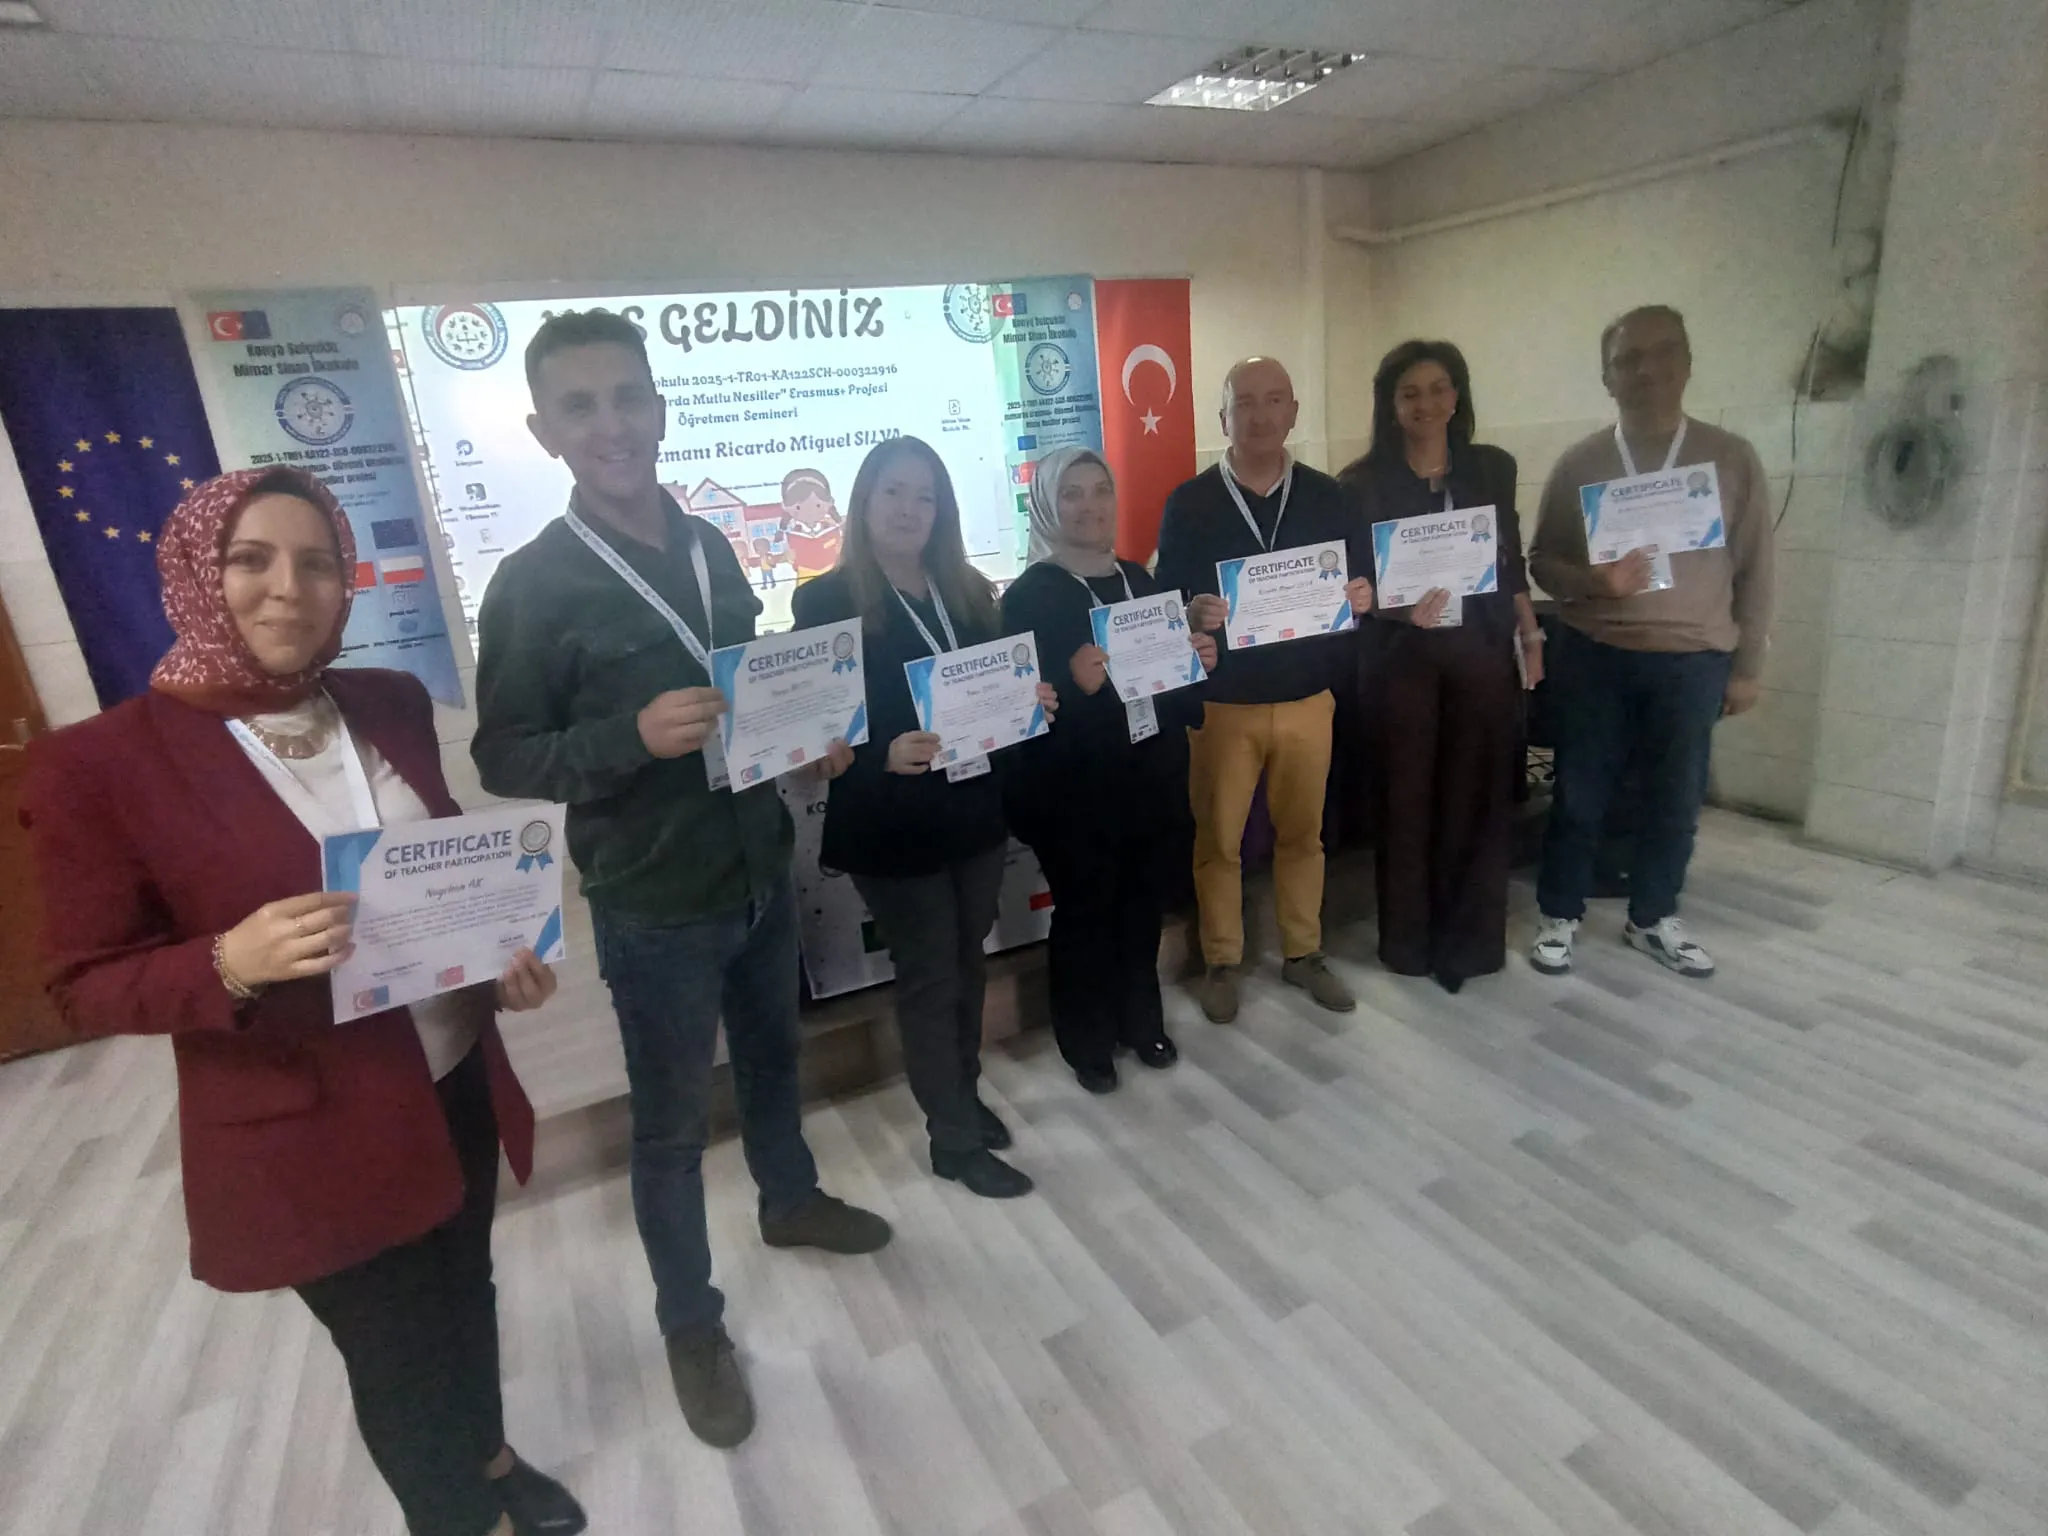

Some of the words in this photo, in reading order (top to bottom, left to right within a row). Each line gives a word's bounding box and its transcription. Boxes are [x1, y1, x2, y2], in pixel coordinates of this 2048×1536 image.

[660, 288, 884, 353] GELDİNİZ
[692, 392, 731, 405] Mutlu
[789, 387, 846, 399] Erasmus+
[848, 382, 888, 396] Projesi
[678, 411, 739, 428] Öğretmen
[744, 407, 798, 421] Semineri
[715, 438, 786, 458] Ricardo
[790, 432, 851, 453] Miguel
[1400, 520, 1466, 538] CERTIFICATE
[1248, 556, 1315, 577] CERTIFICATE
[1113, 606, 1163, 626] CERTIFICATE
[748, 640, 828, 672] CERTIFICATE
[941, 651, 1009, 678] CERTIFICATE
[384, 829, 513, 865] CERTIFICATE
[384, 869, 398, 880] OF
[400, 861, 443, 877] TEACHER
[444, 849, 513, 870] PARTICIPATION
